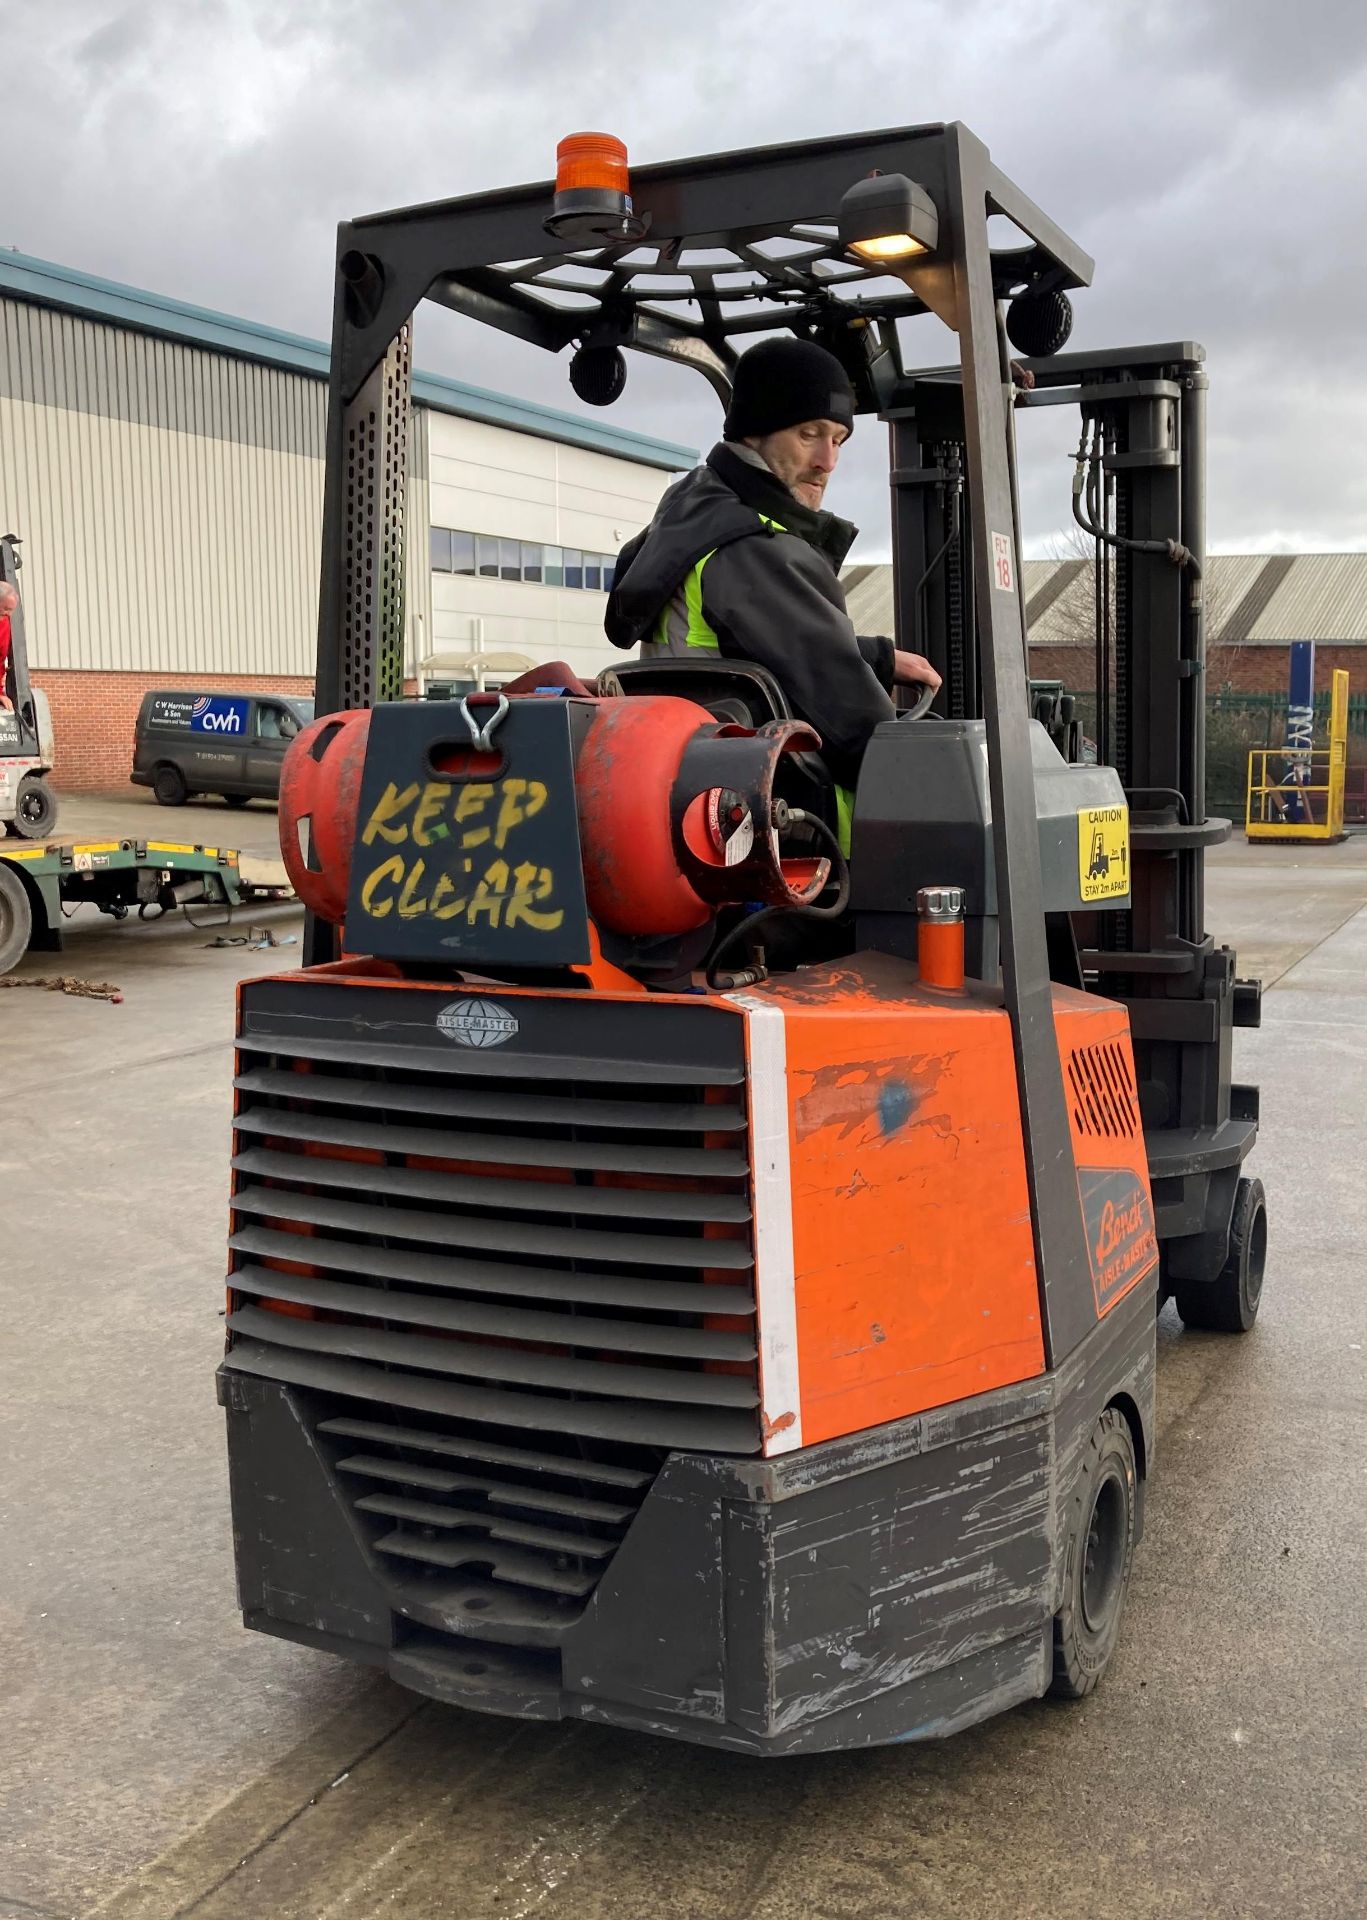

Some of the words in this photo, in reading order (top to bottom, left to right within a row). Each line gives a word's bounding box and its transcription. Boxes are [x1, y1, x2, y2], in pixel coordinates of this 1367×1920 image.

[995, 537, 1008, 555] FLT
[996, 557, 1010, 587] 18
[161, 701, 168, 709] W
[169, 709, 181, 718] Son
[202, 706, 240, 732] cwh
[362, 778, 548, 850] KEEP
[1088, 809, 1122, 824] CAUTION
[361, 854, 565, 931] CLEAR
[1085, 885, 1100, 897] STAY
[1100, 883, 1110, 894] 2m
[1110, 880, 1127, 892] APART
[1095, 1189, 1144, 1267] Bendi
